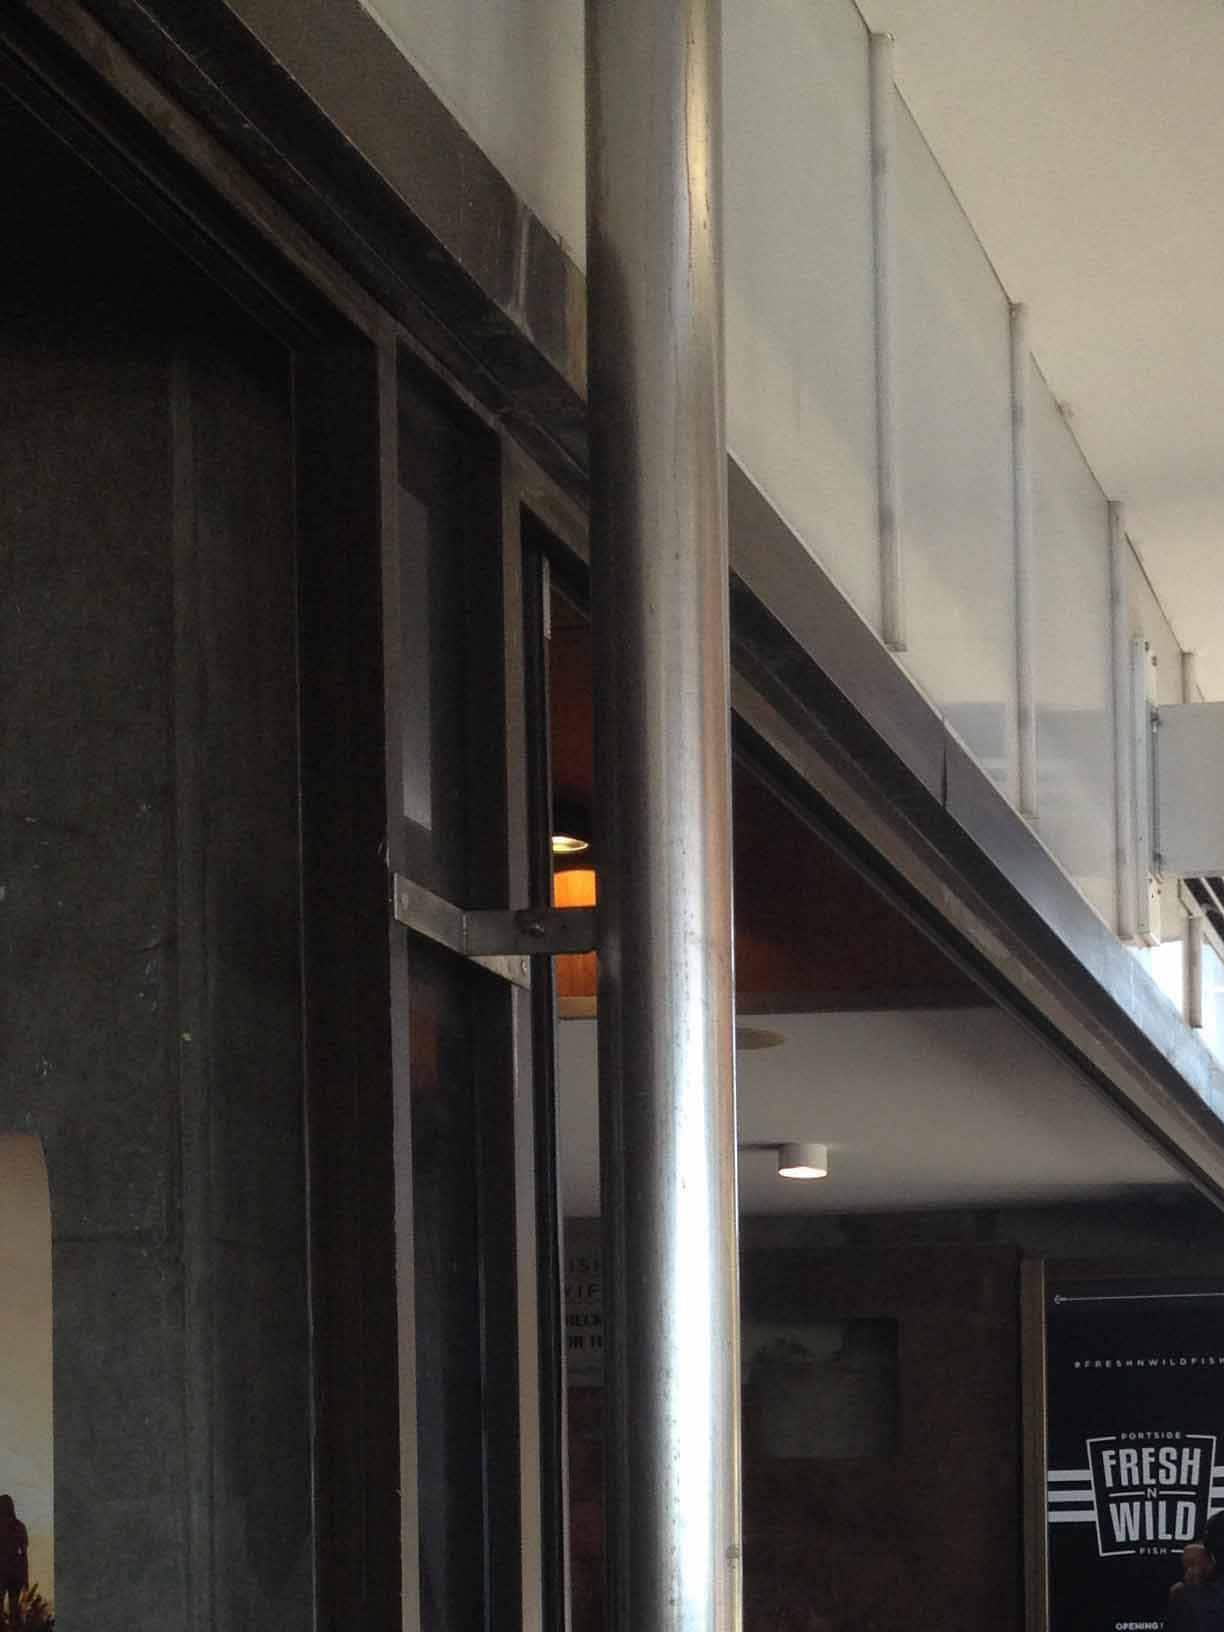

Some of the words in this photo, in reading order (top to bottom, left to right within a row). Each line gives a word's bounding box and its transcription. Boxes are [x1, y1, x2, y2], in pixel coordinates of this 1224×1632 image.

[1120, 1431, 1182, 1441] PORTSIDE
[1102, 1447, 1202, 1487] FRESH
[1146, 1487, 1158, 1499] N
[1109, 1500, 1197, 1542] WILD
[1139, 1547, 1168, 1556] FISH
[1114, 1621, 1159, 1631] OPENING
